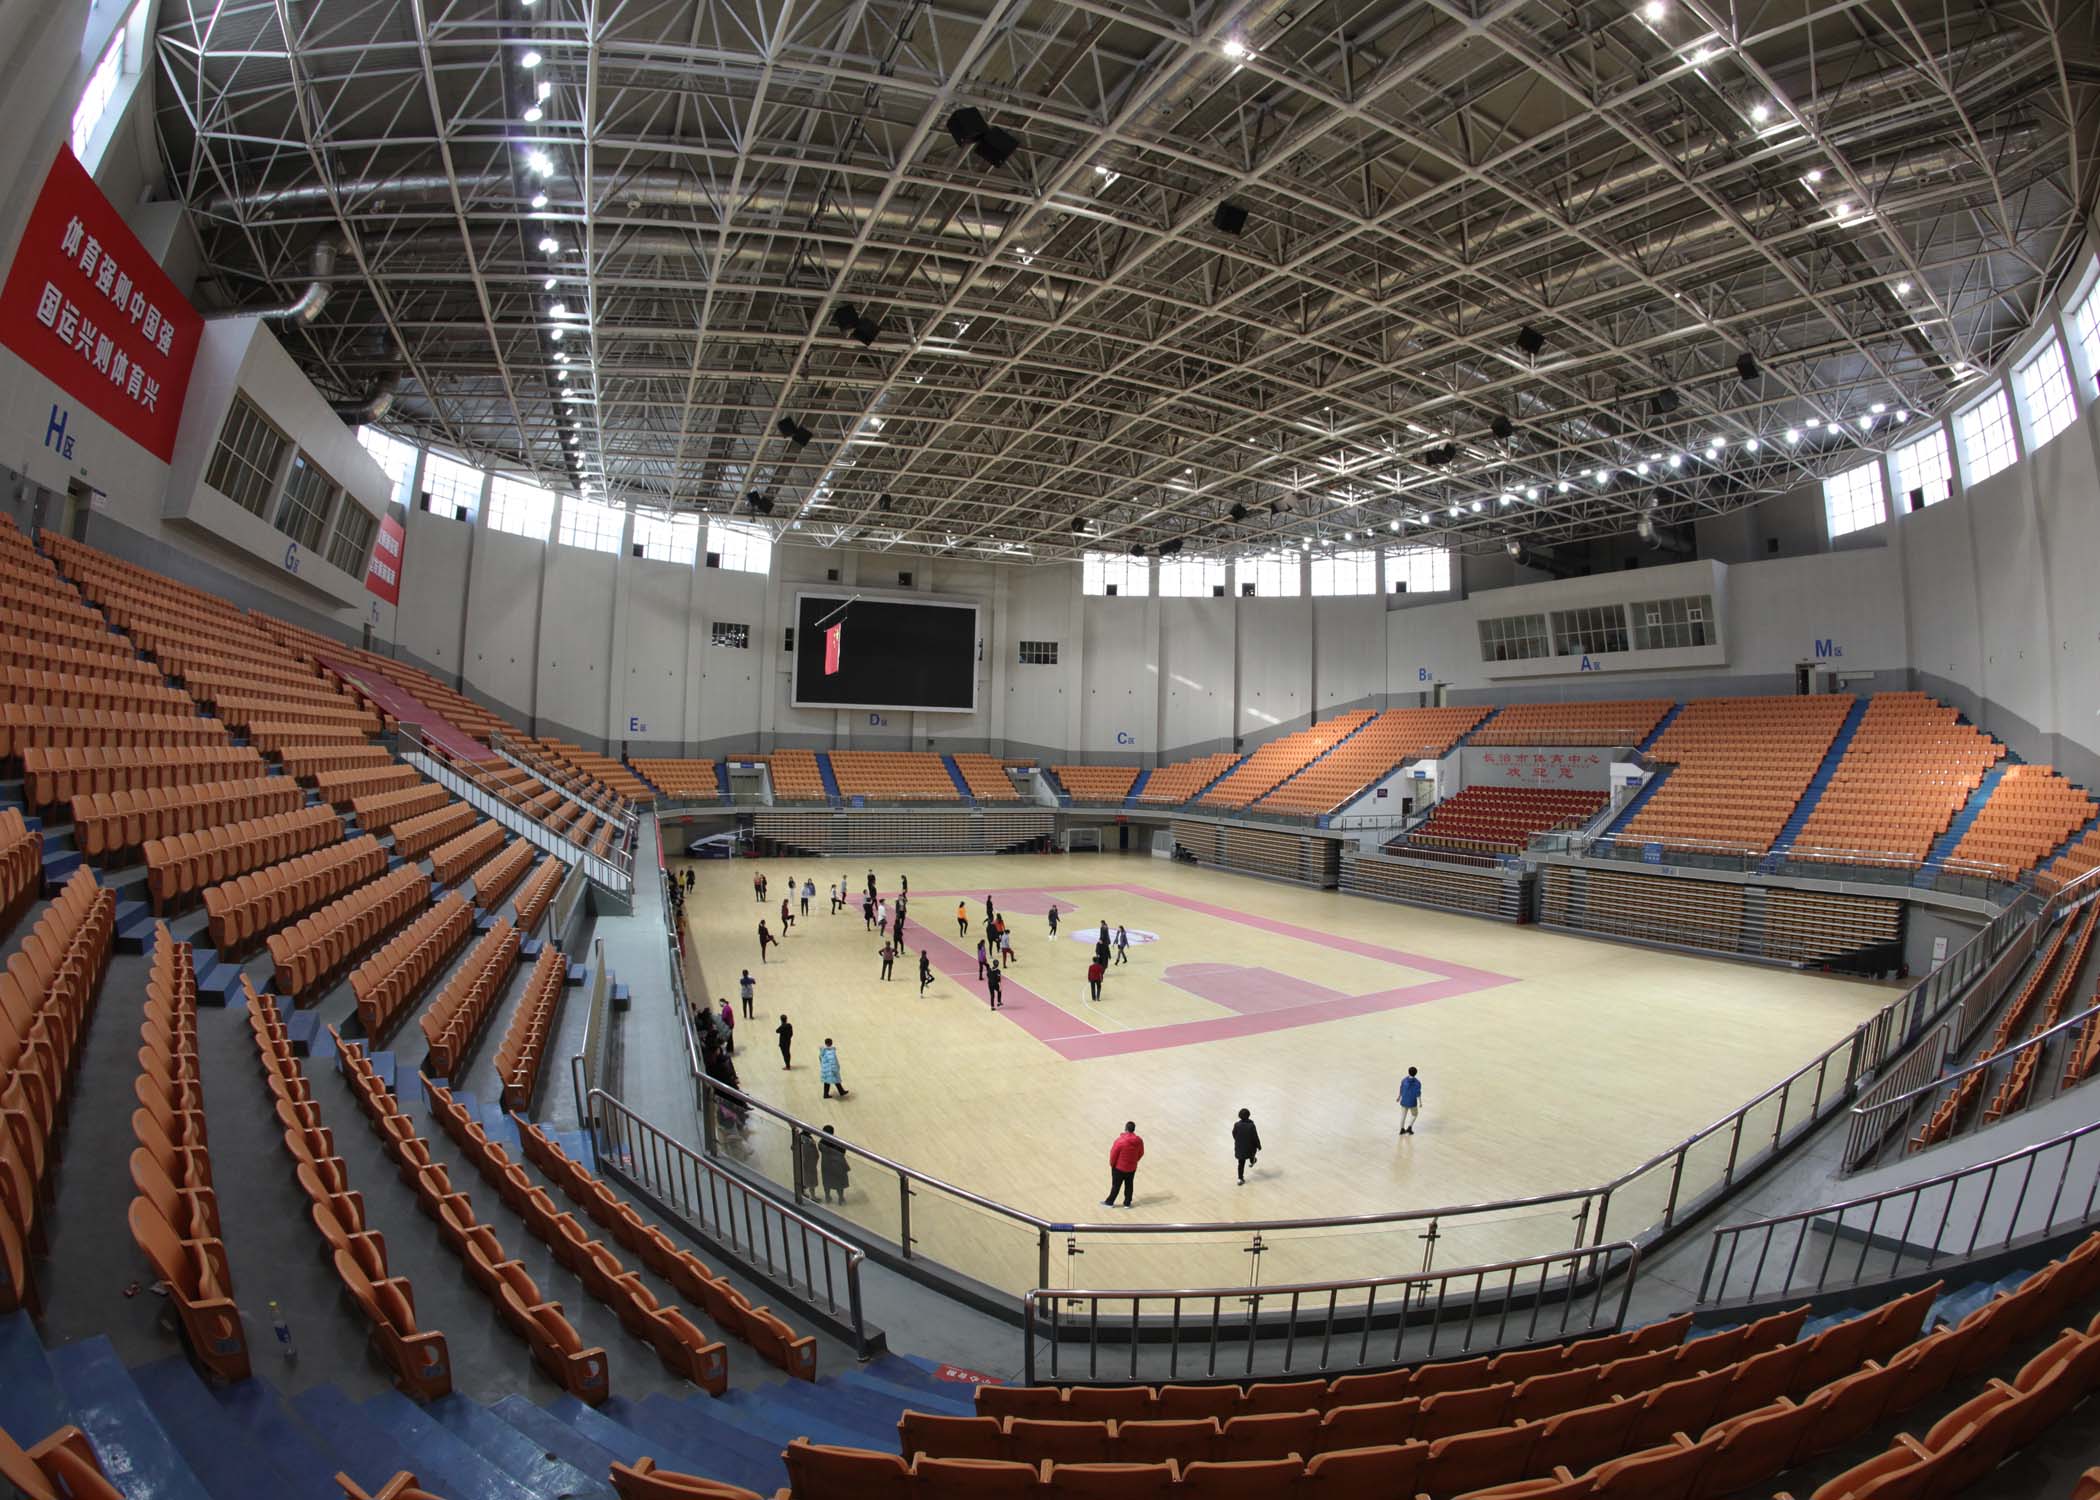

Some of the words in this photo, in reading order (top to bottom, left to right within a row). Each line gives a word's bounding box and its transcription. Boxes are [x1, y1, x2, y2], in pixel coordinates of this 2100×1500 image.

[60, 215, 175, 358] 体育强则中国强
[36, 281, 160, 414] 国运兴则体育兴
[44, 403, 76, 461] H区
[1815, 639, 1843, 657] M区
[1482, 751, 1601, 764] 长治市体育中心
